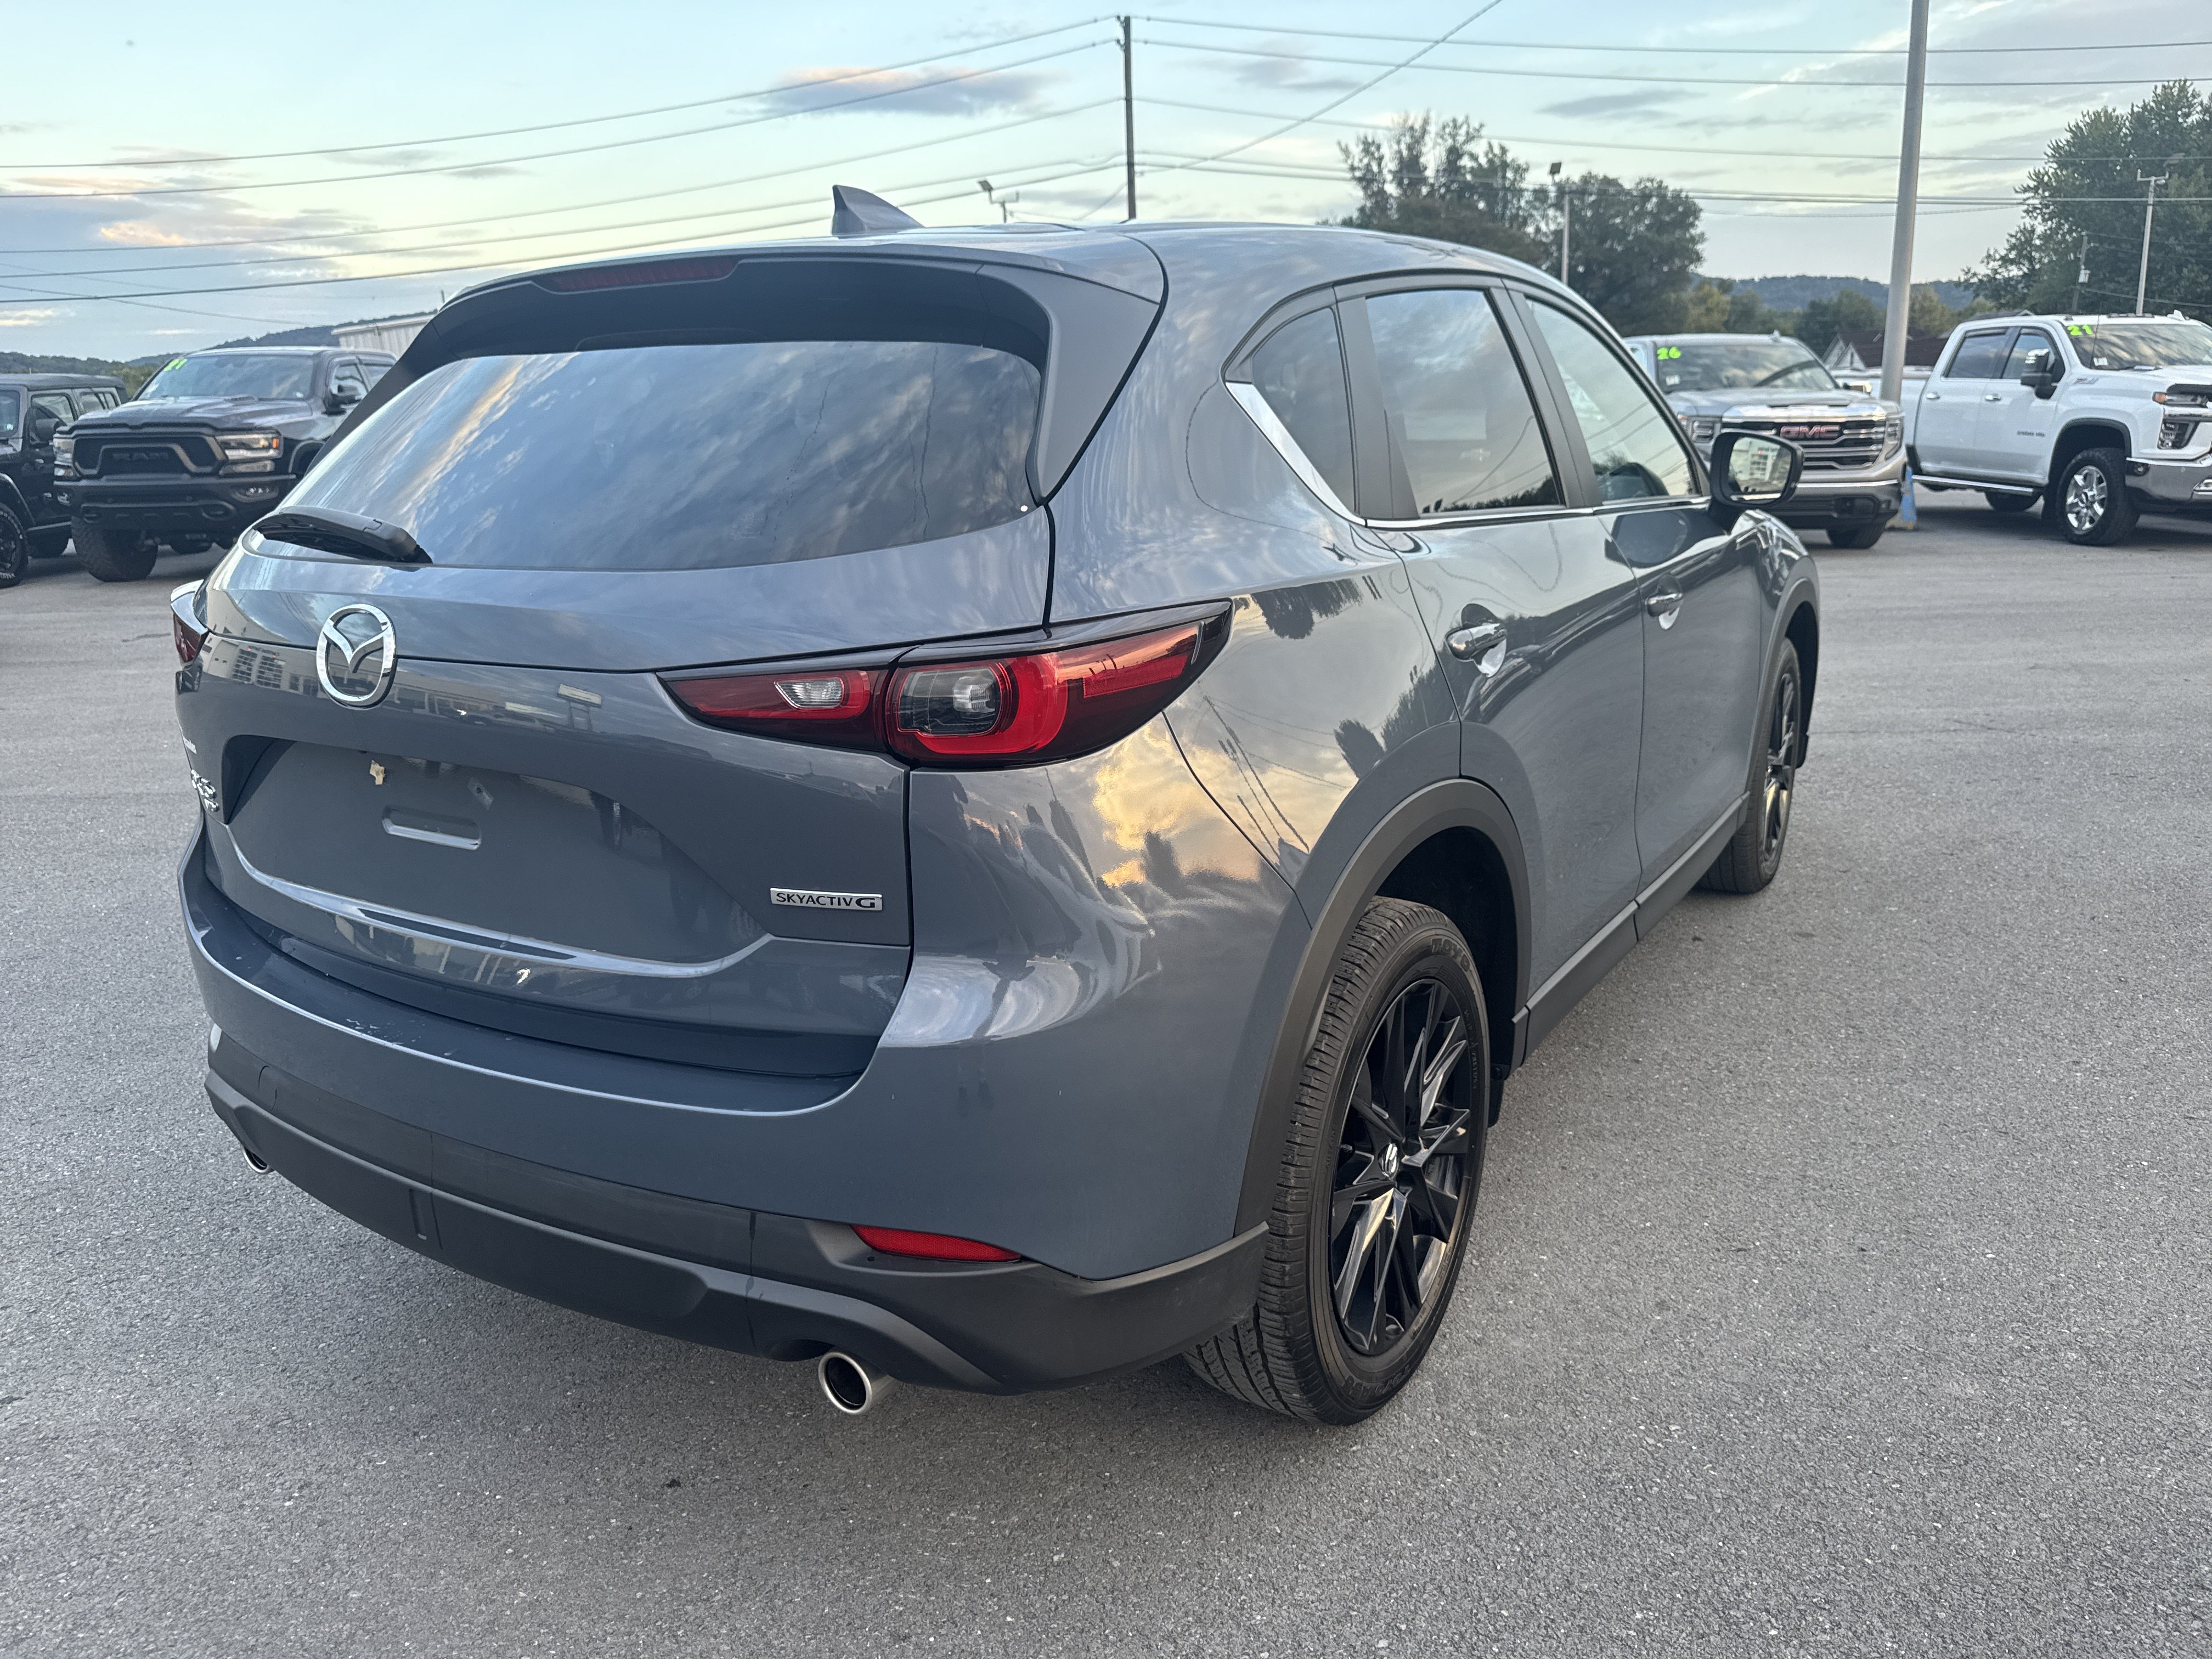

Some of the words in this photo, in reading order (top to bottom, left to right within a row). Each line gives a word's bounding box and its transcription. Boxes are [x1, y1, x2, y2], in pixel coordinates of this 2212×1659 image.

[2067, 324, 2093, 336] 21
[1656, 346, 1681, 360] 26
[1780, 425, 1841, 439] GMC
[1431, 938, 1470, 972] TOYO
